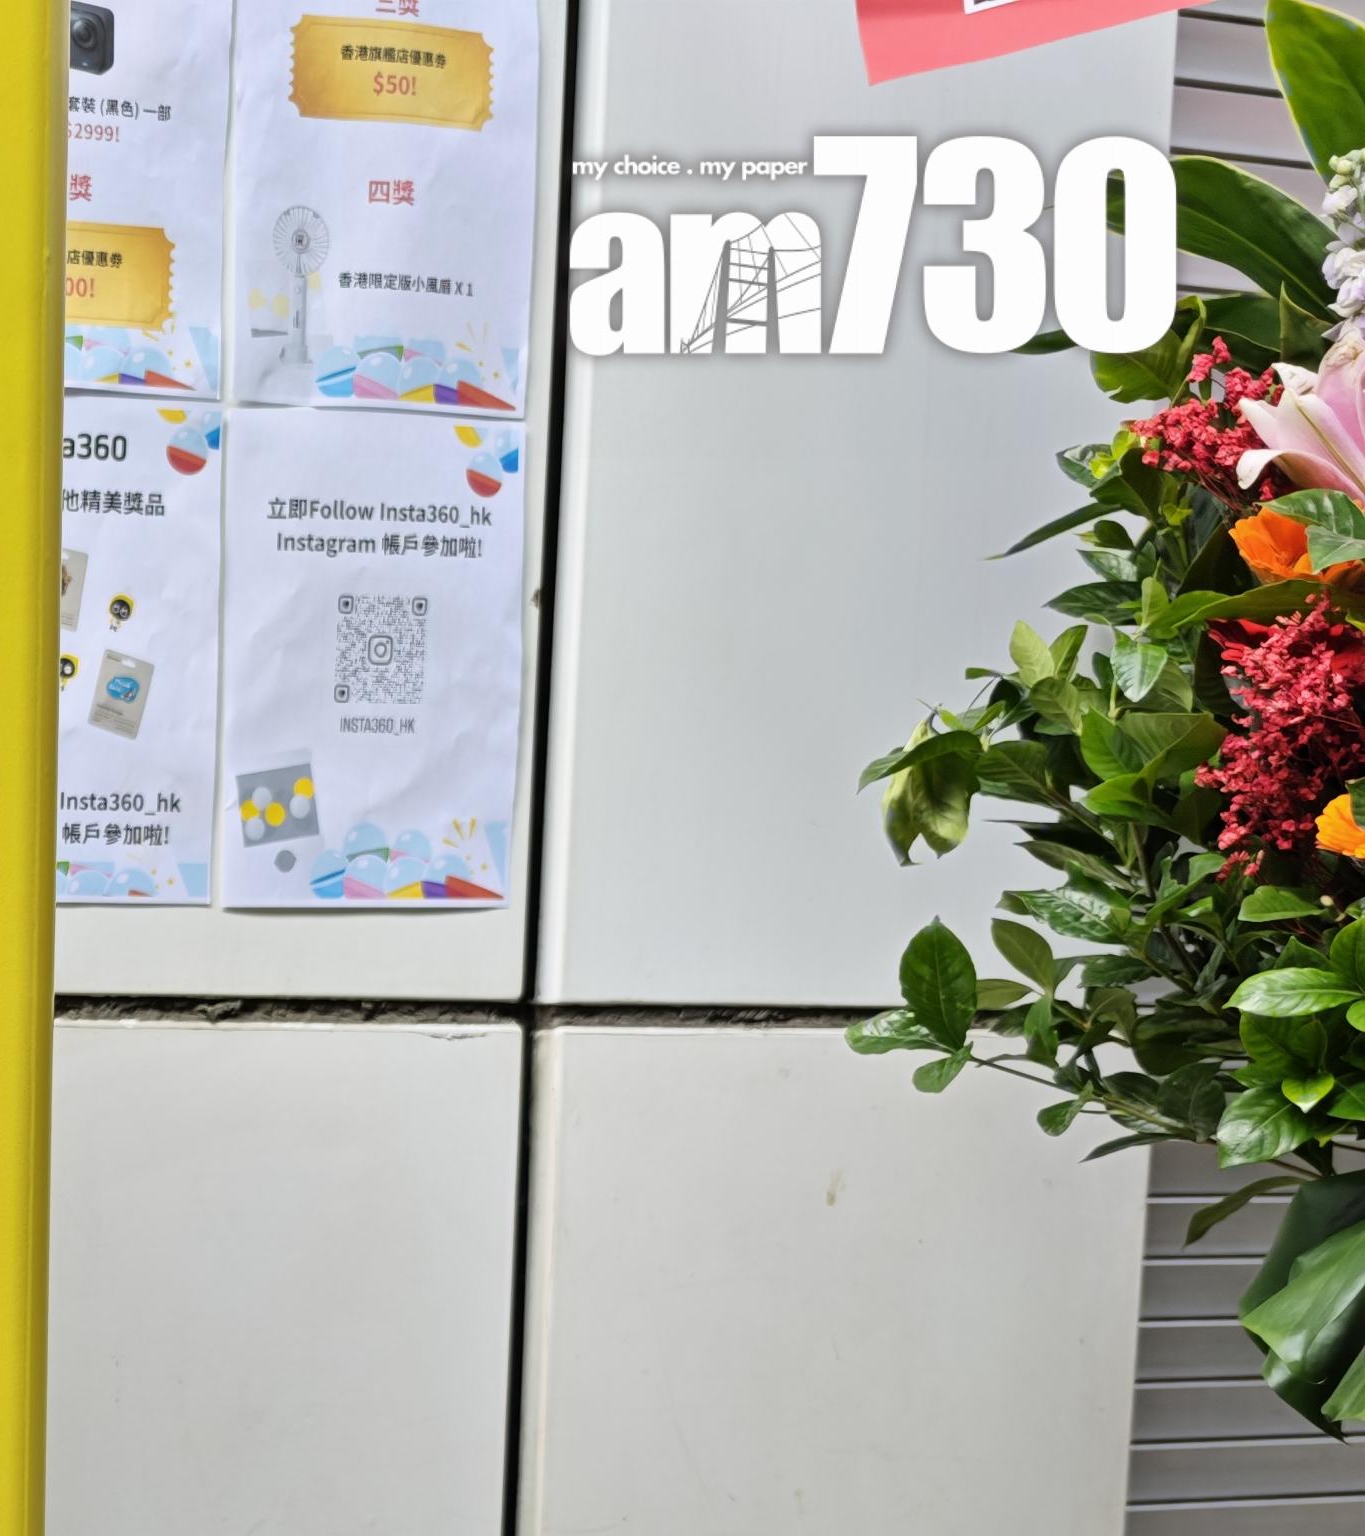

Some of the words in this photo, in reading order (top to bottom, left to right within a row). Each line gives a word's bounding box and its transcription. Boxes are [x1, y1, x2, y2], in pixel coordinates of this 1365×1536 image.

[373, 71, 417, 96] $50!
[100, 98, 139, 120] (黑色)
[143, 104, 171, 122] 一部
[368, 180, 415, 206] 四獎
[339, 272, 451, 295] 香港限定版小風扇
[63, 433, 128, 462] a360
[267, 497, 373, 521] 立即Follow
[380, 502, 492, 529] Insta360_hk
[277, 532, 376, 558] Instagram
[382, 533, 482, 559] 帳戶參加啦!
[339, 715, 415, 736] INSTA360_HK
[60, 791, 181, 815] Insta360_hk
[62, 823, 169, 846] 帳戶參加啦!
